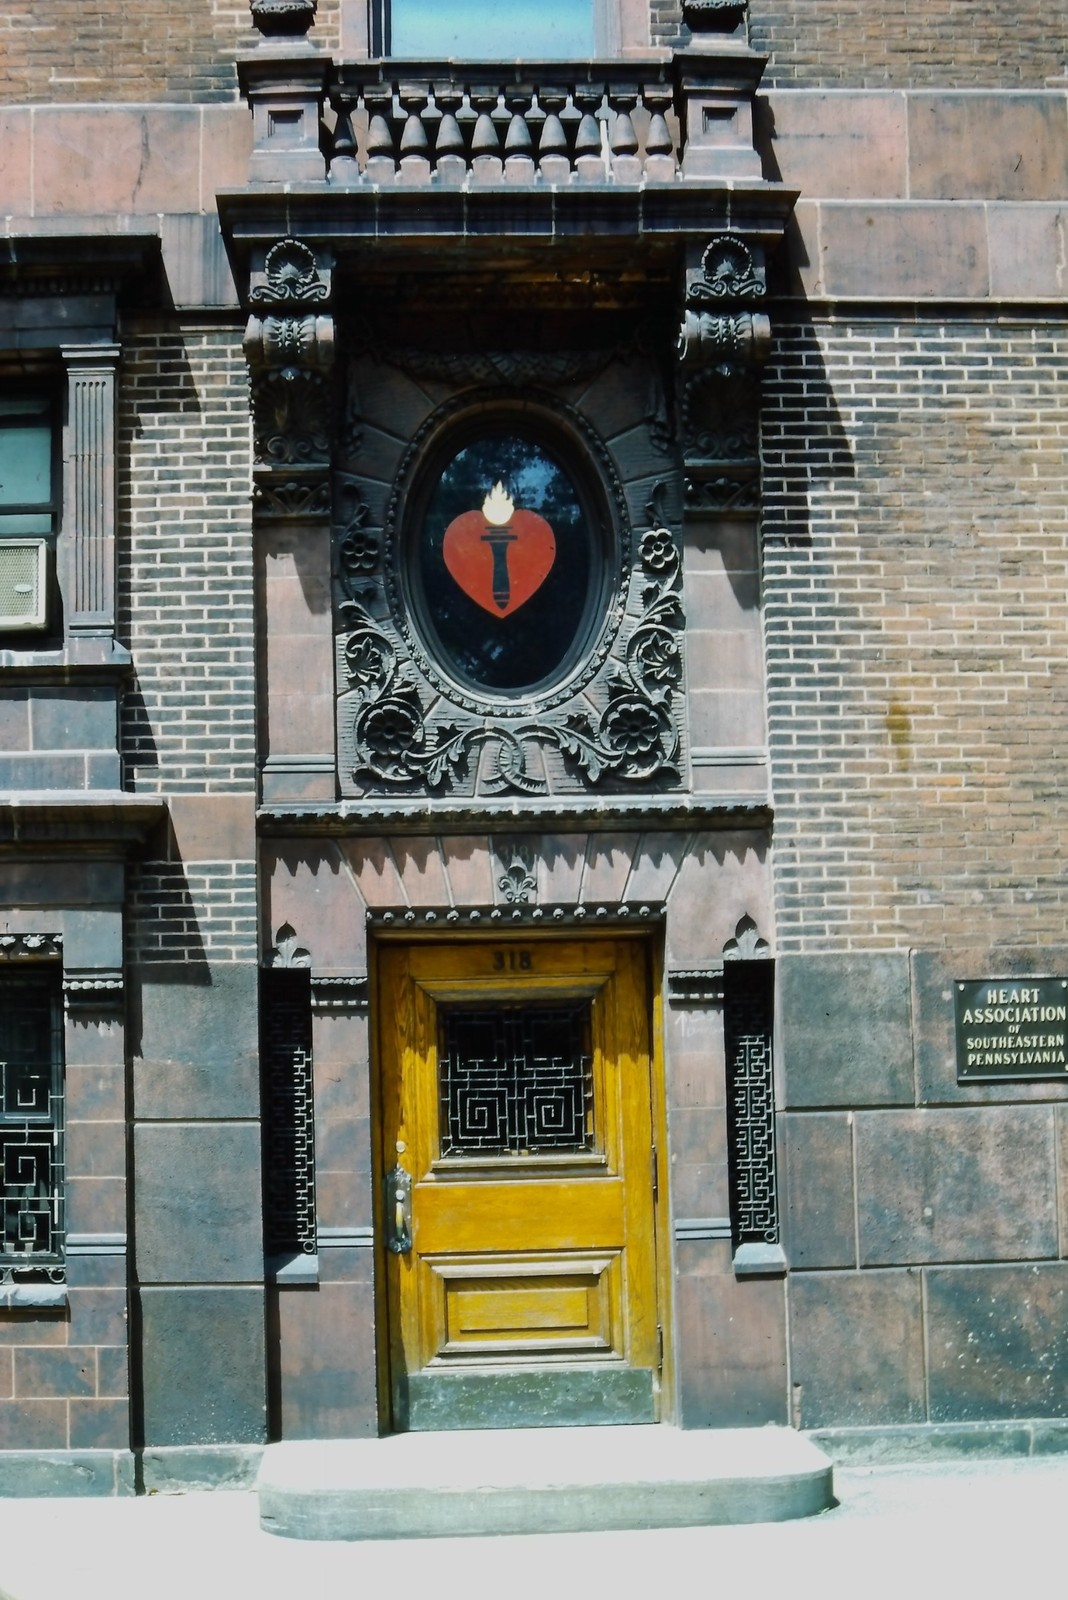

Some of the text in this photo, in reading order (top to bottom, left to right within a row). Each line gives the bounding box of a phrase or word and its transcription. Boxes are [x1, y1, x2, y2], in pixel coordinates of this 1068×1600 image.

[499, 844, 530, 863] 318
[493, 951, 532, 970] 318
[987, 989, 1040, 1004] HEART
[963, 1006, 1066, 1024] ASSOCIATION
[1008, 1025, 1021, 1034] OF
[967, 1034, 1064, 1050] SOUTHEASTERN
[968, 1051, 1065, 1066] PENNSYLVANIA
